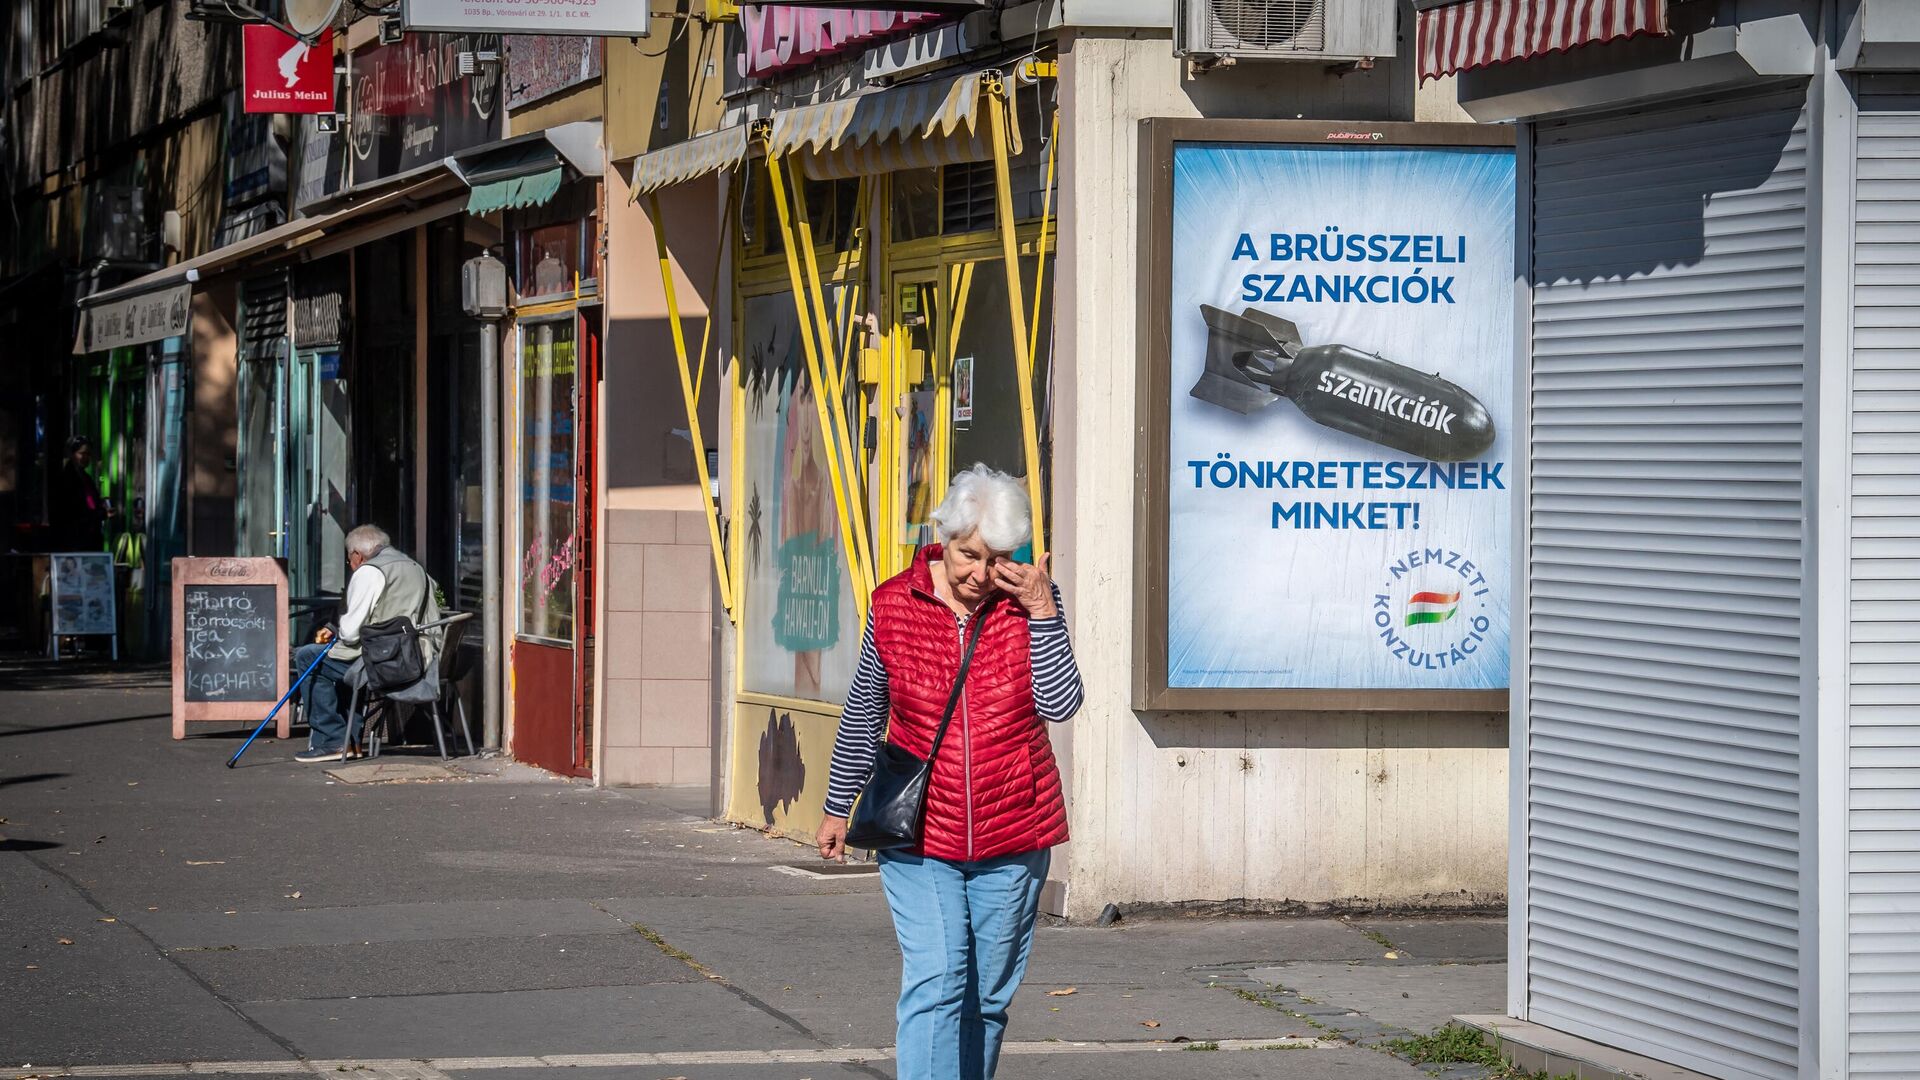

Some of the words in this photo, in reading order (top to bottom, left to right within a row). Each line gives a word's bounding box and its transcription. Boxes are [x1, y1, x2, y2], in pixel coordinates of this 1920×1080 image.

[252, 90, 291, 99] Julius
[294, 91, 328, 100] Meinl
[1231, 232, 1259, 261] A
[1270, 225, 1466, 263] BRÜSSZELI
[1241, 267, 1456, 304] SZANKCIÓK
[1317, 370, 1457, 435] szankciók
[1187, 452, 1506, 490] TÖNKRETESZNEK
[1271, 501, 1420, 530] MINKET!
[792, 555, 829, 595] BARNULJ
[1388, 547, 1489, 597] NEMZETI
[784, 598, 829, 640] HAWAII-ON
[1373, 593, 1490, 670] KONZULTÁCIÓ
